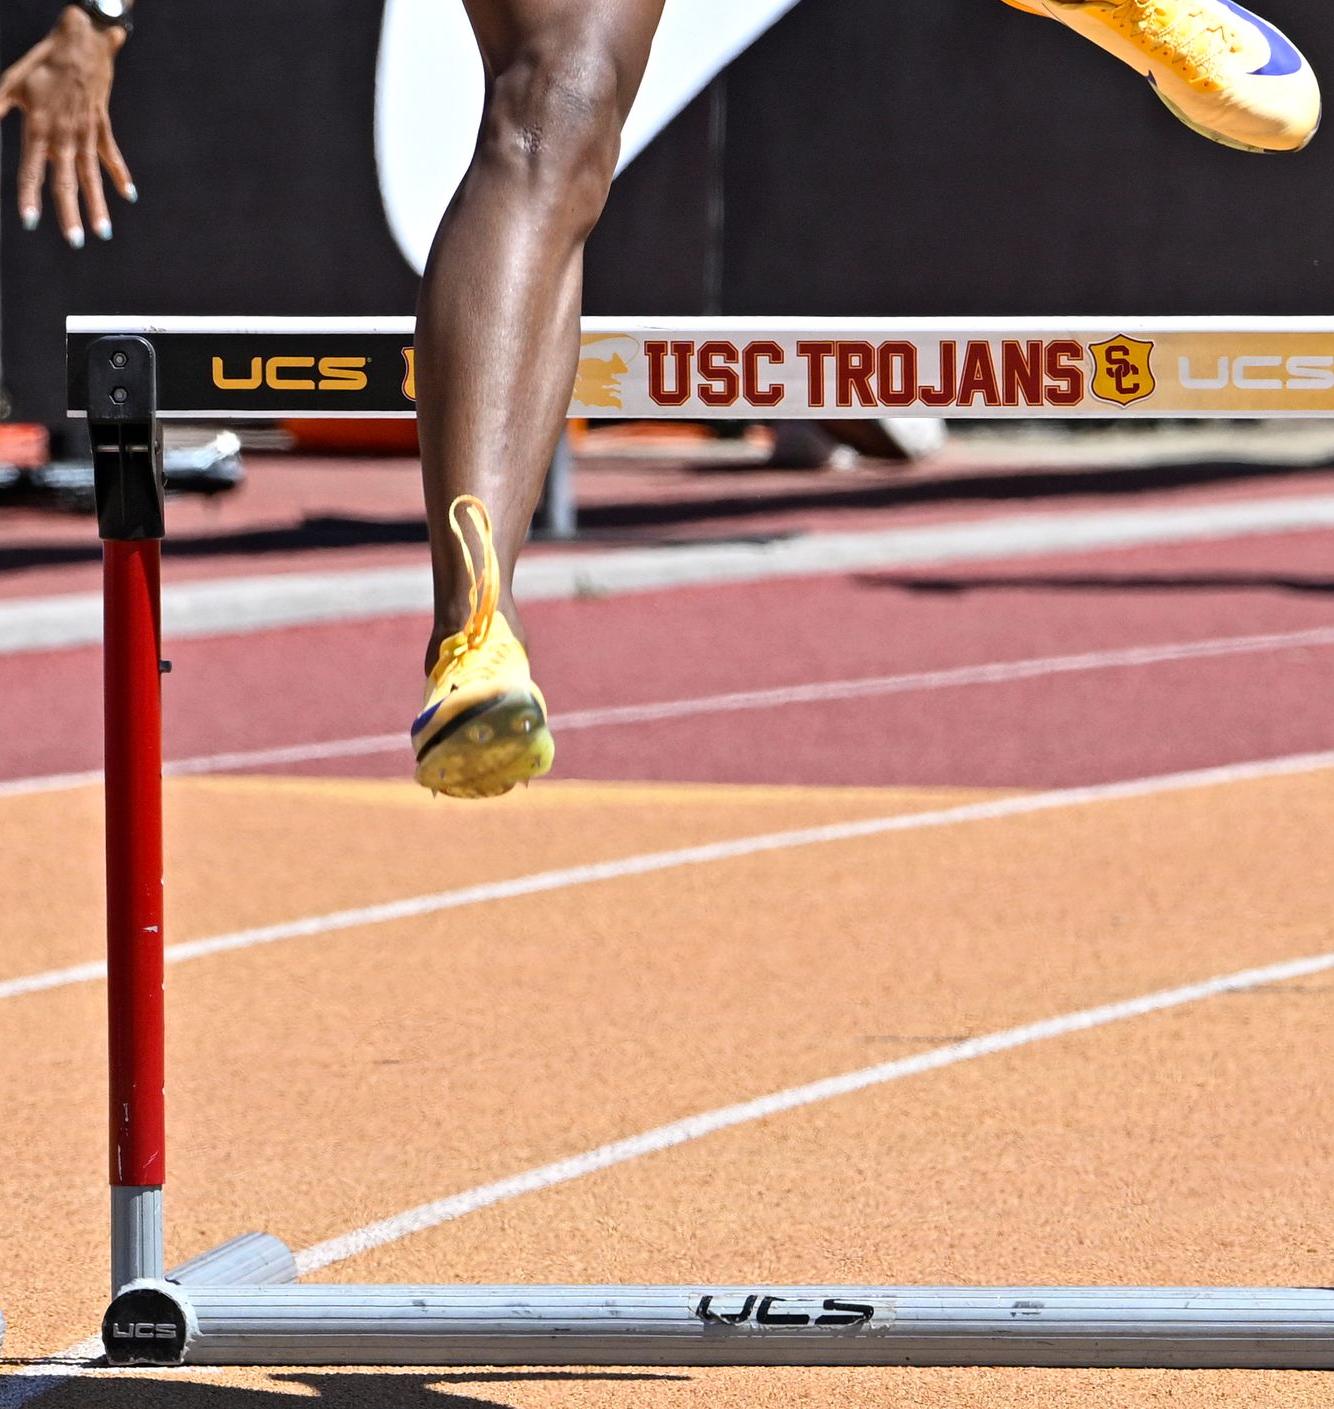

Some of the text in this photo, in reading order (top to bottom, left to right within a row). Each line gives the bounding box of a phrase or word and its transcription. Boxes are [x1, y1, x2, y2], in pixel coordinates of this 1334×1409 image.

[212, 357, 368, 390] UCS
[643, 340, 1085, 407] USC TROJANS
[113, 1322, 177, 1339] UCS
